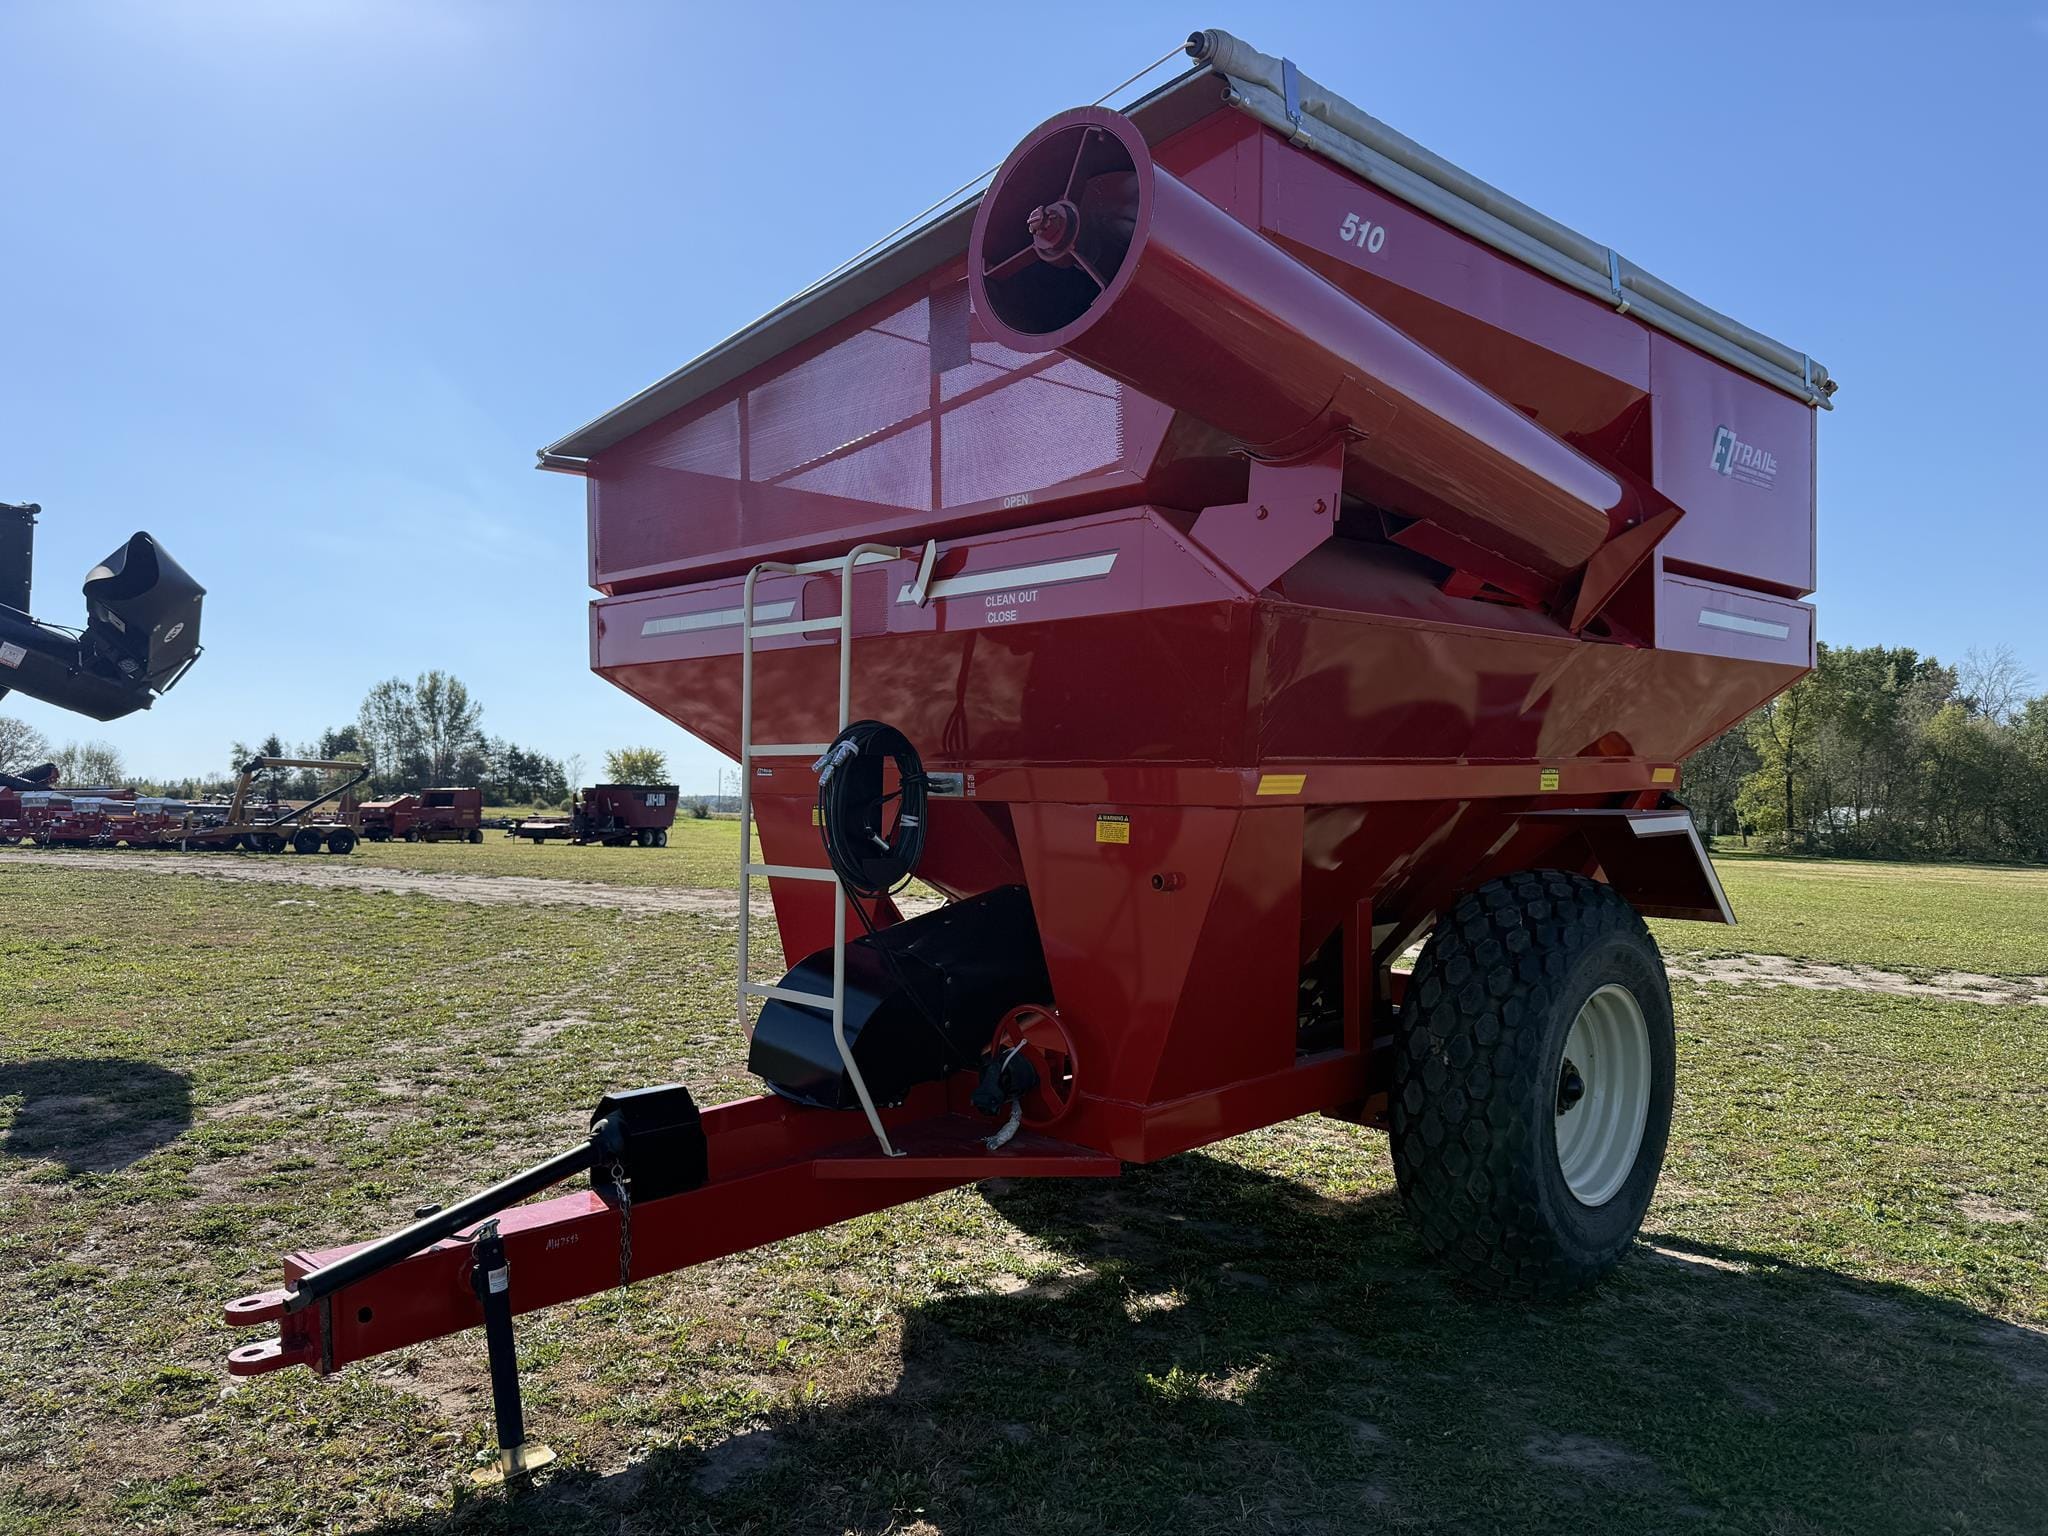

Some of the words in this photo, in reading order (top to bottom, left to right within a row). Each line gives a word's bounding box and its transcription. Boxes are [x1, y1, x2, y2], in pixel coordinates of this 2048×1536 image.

[1340, 212, 1385, 253] 510
[1003, 494, 1029, 509] OPEN
[985, 593, 1016, 607] CLEAN
[1018, 590, 1038, 603] OUT
[987, 610, 1017, 623] CLOSE
